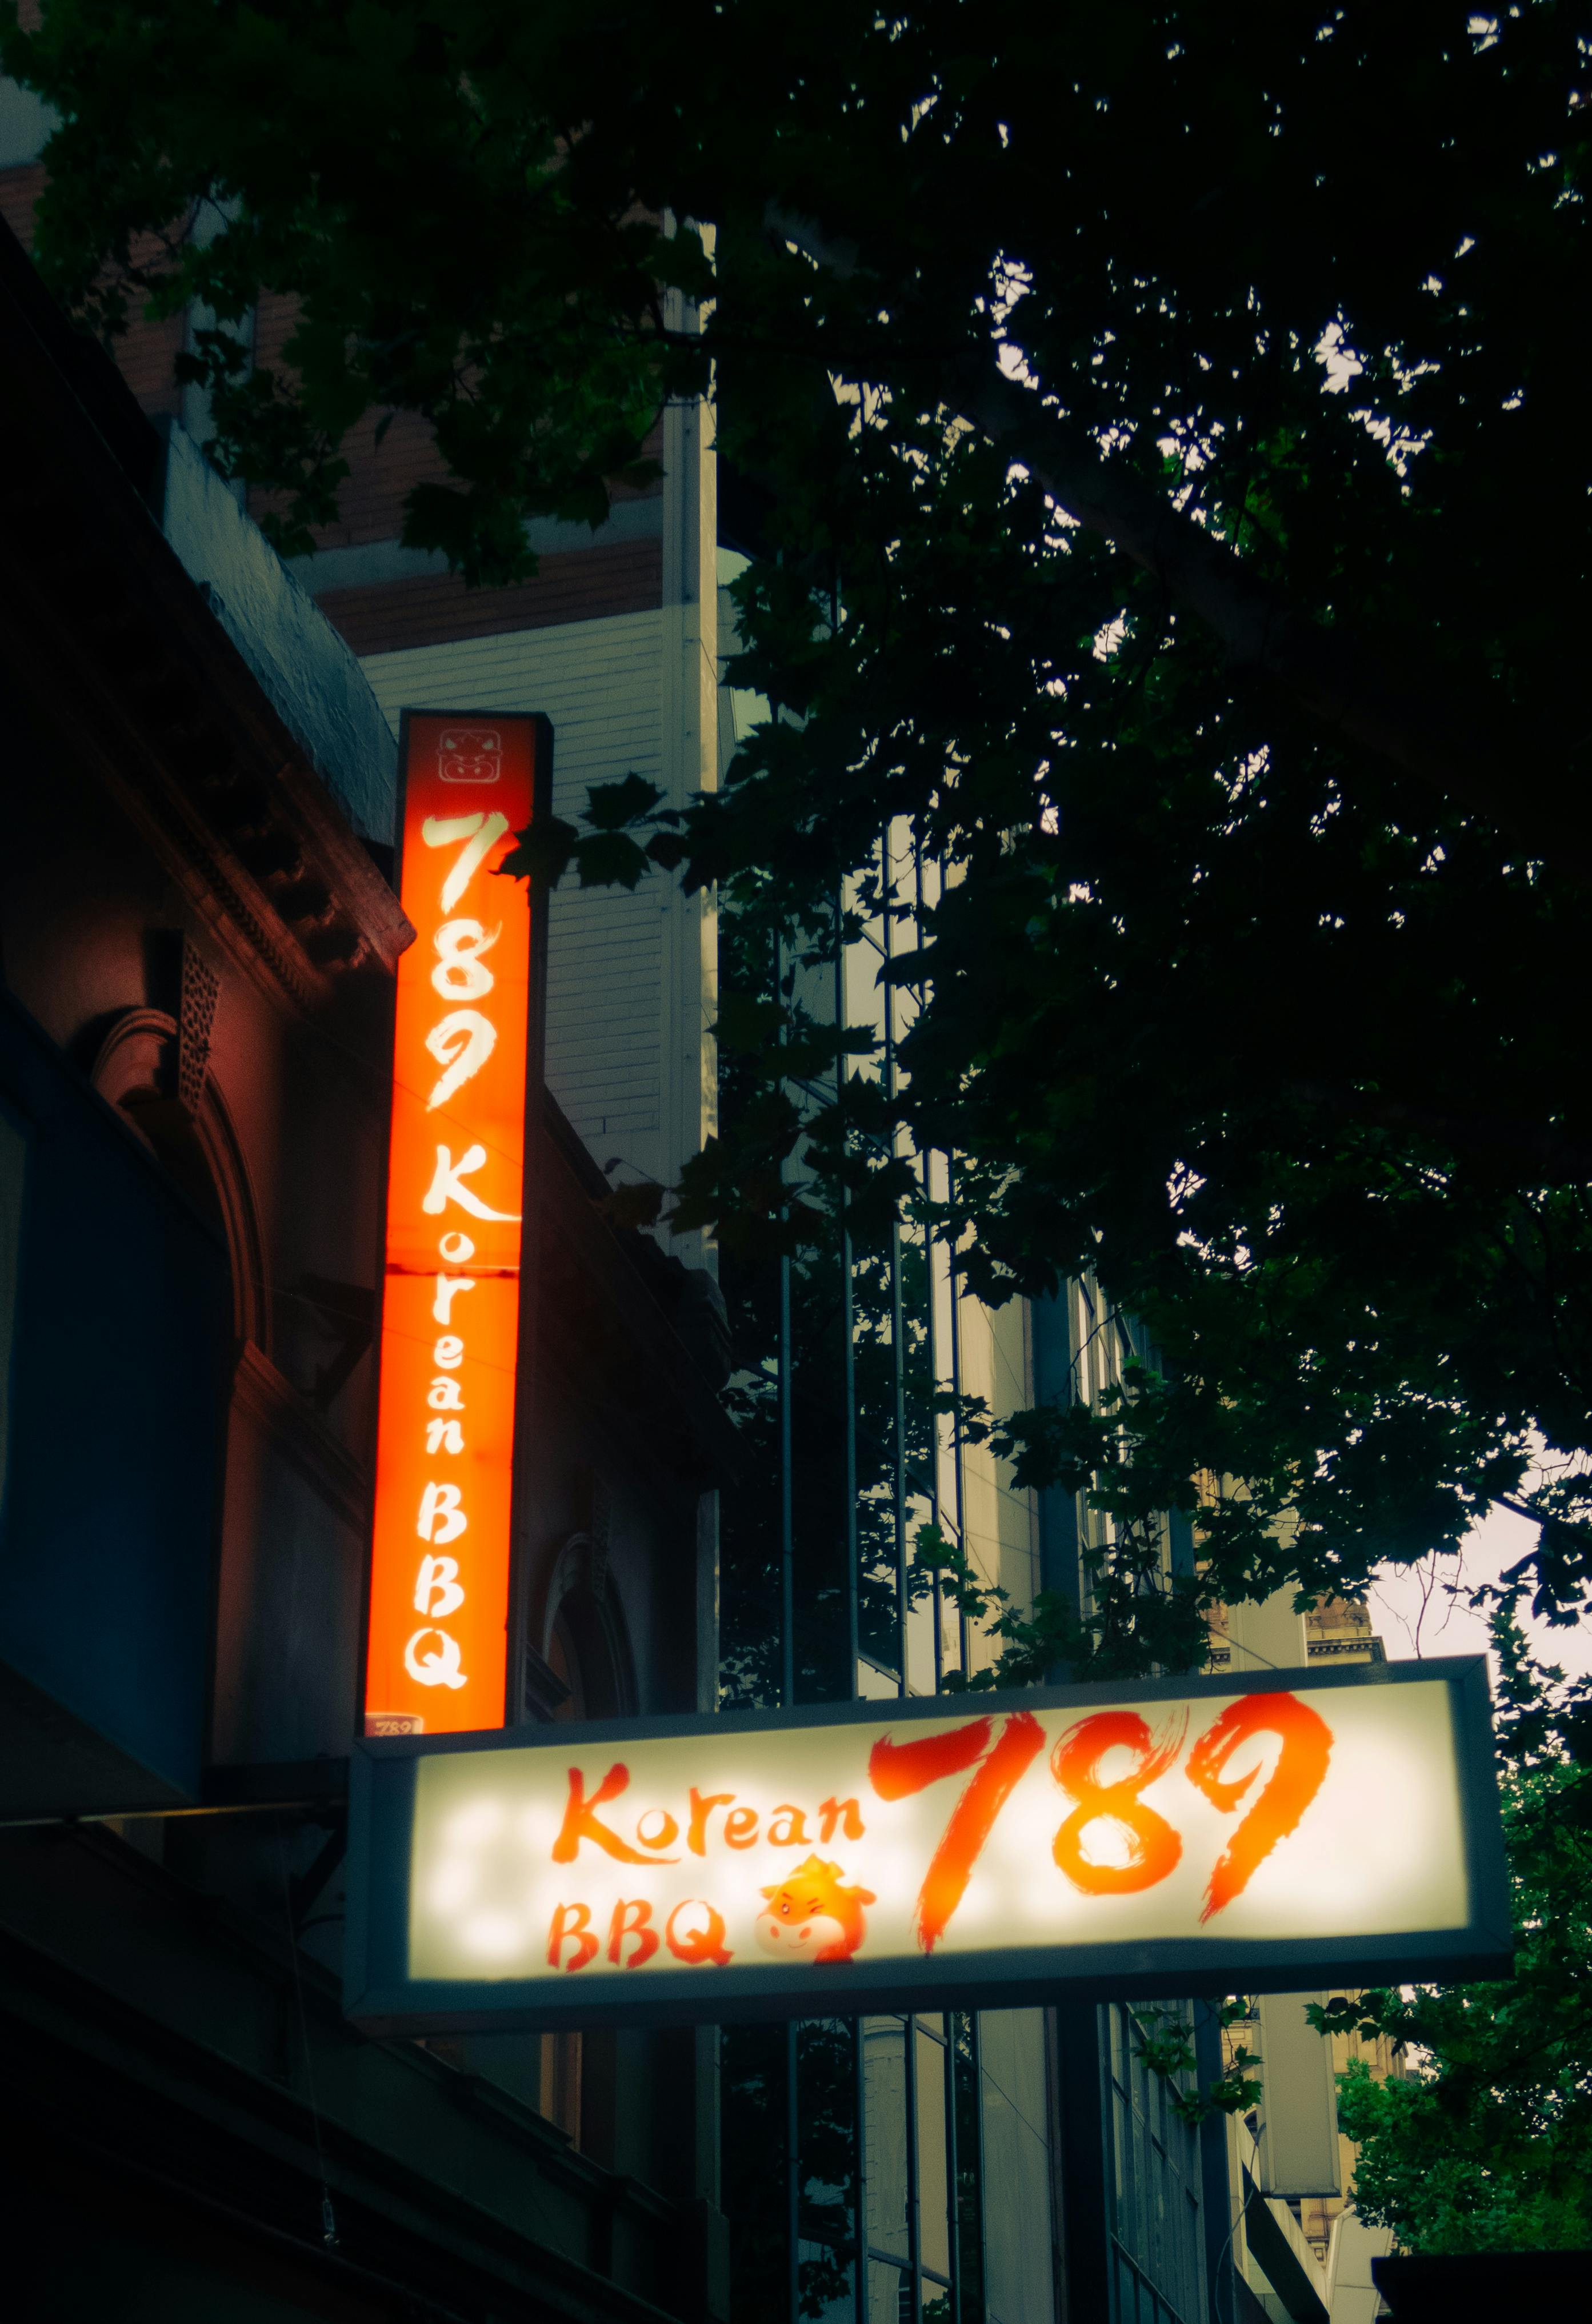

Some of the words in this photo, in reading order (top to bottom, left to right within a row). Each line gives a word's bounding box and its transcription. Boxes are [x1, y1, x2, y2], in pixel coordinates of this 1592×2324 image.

[422, 811, 509, 1112] 789
[422, 1144, 522, 1454] Korean
[404, 1481, 467, 1689] BBQ
[375, 1721, 412, 1736] 789
[551, 1762, 866, 1865] Korean
[867, 1691, 1335, 1960] 789
[546, 1898, 735, 1973] BBQ
